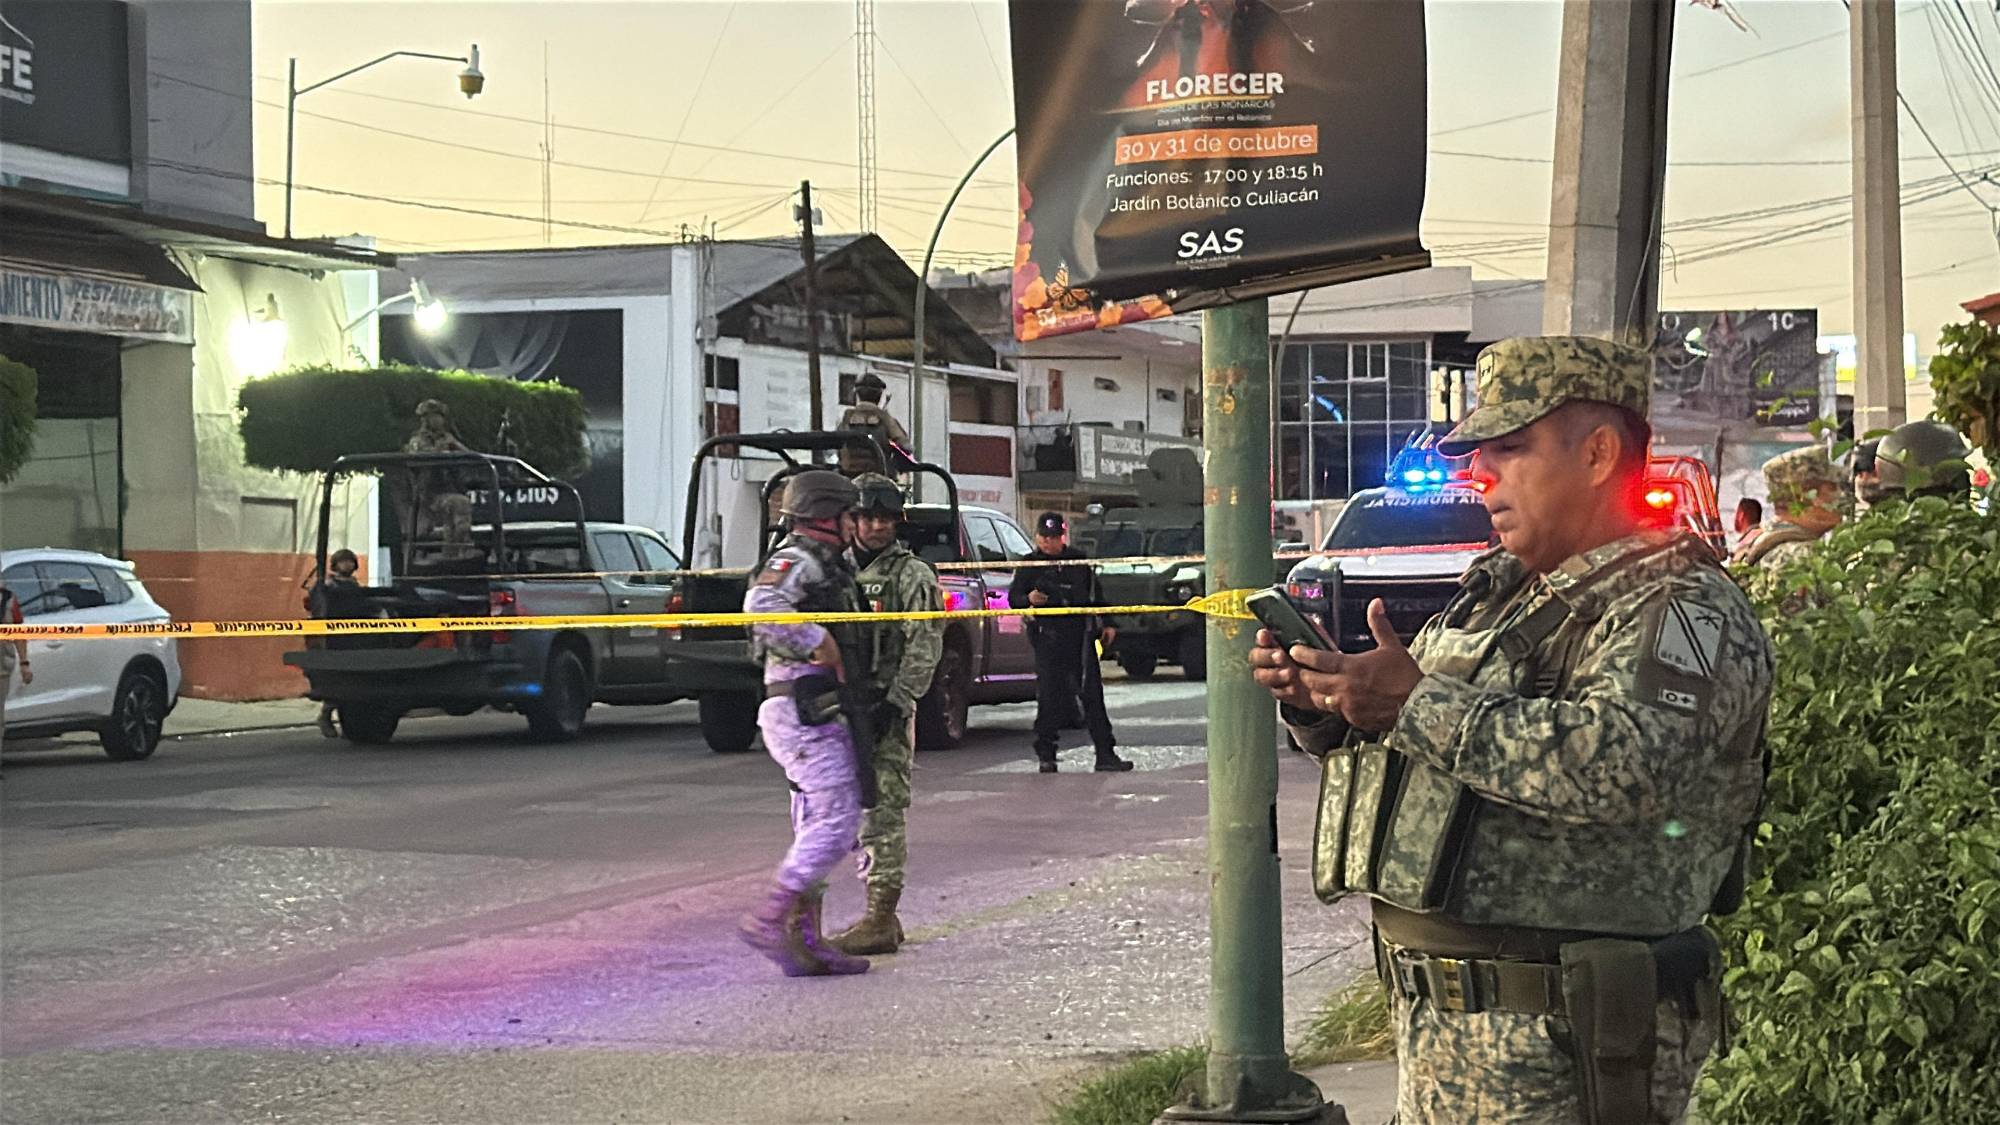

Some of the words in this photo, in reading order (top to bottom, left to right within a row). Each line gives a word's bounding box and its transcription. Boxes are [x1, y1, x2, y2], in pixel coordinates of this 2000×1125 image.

[1147, 72, 1284, 102] FLORECER
[1201, 101, 1219, 110] LAS
[1120, 142, 1145, 161] 30
[1149, 143, 1162, 161] y
[1165, 138, 1187, 156] 31
[1194, 134, 1220, 152] de
[1228, 131, 1312, 151] octubre
[1106, 169, 1193, 189] Funciones:
[1204, 169, 1248, 183] 17:00
[1252, 170, 1263, 184] y
[1267, 166, 1308, 181] 18:15
[1313, 163, 1324, 177] h
[1246, 188, 1319, 206] Culiacán
[1177, 228, 1244, 258] SAS
